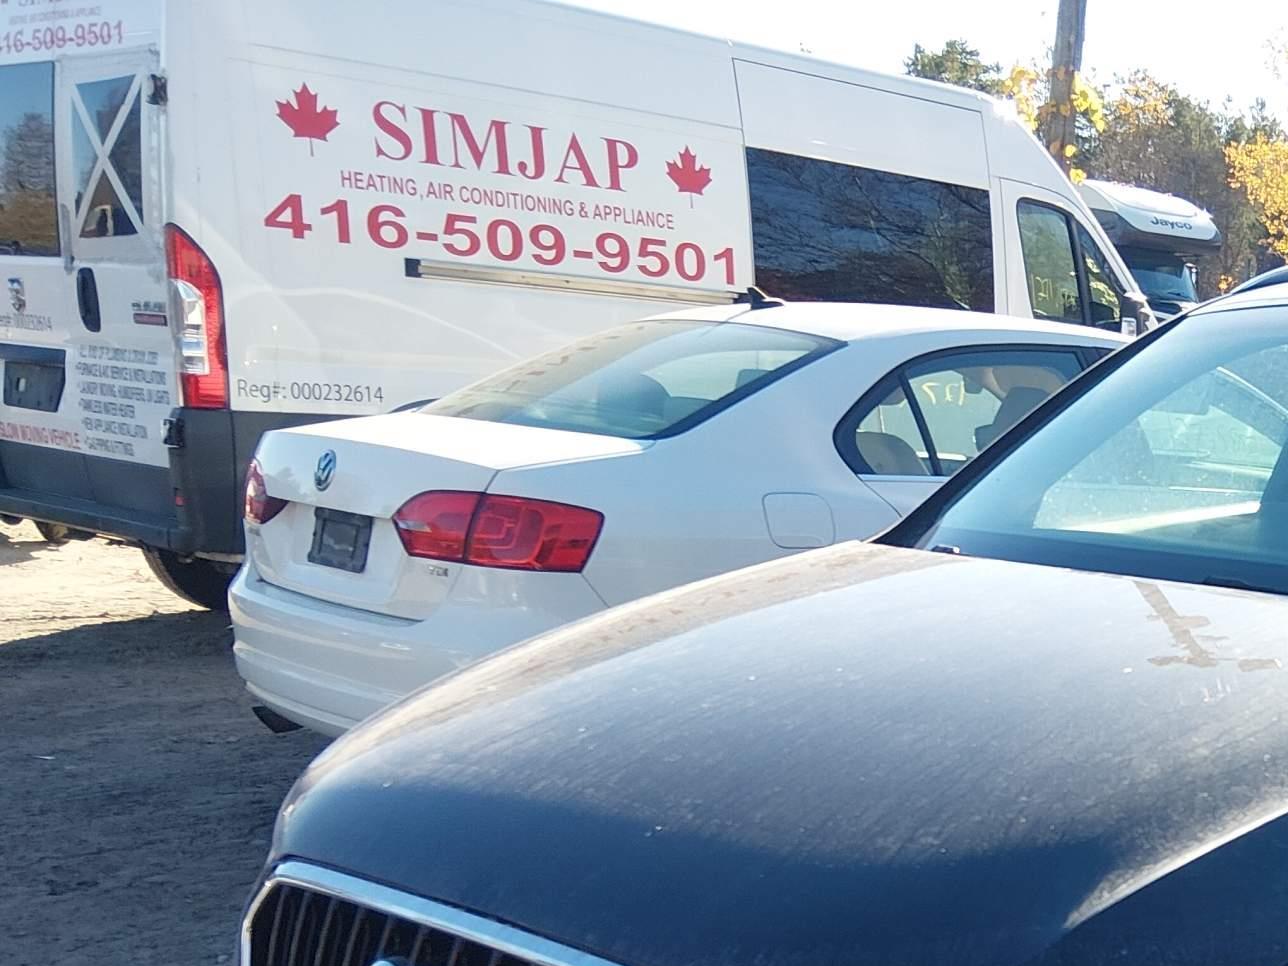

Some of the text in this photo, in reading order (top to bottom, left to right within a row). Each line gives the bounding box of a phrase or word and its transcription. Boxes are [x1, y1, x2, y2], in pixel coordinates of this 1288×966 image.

[0, 20, 123, 54] 16-509-9501
[372, 100, 640, 192] SIMJAP
[426, 181, 455, 201] AIR
[459, 185, 575, 217] CONDITIONING
[578, 201, 590, 219] &
[592, 203, 675, 230] APPLIANCE
[1150, 216, 1193, 231] Jayco
[263, 192, 736, 286] 416-509-9501
[236, 378, 385, 404] Reg#: 000232614
